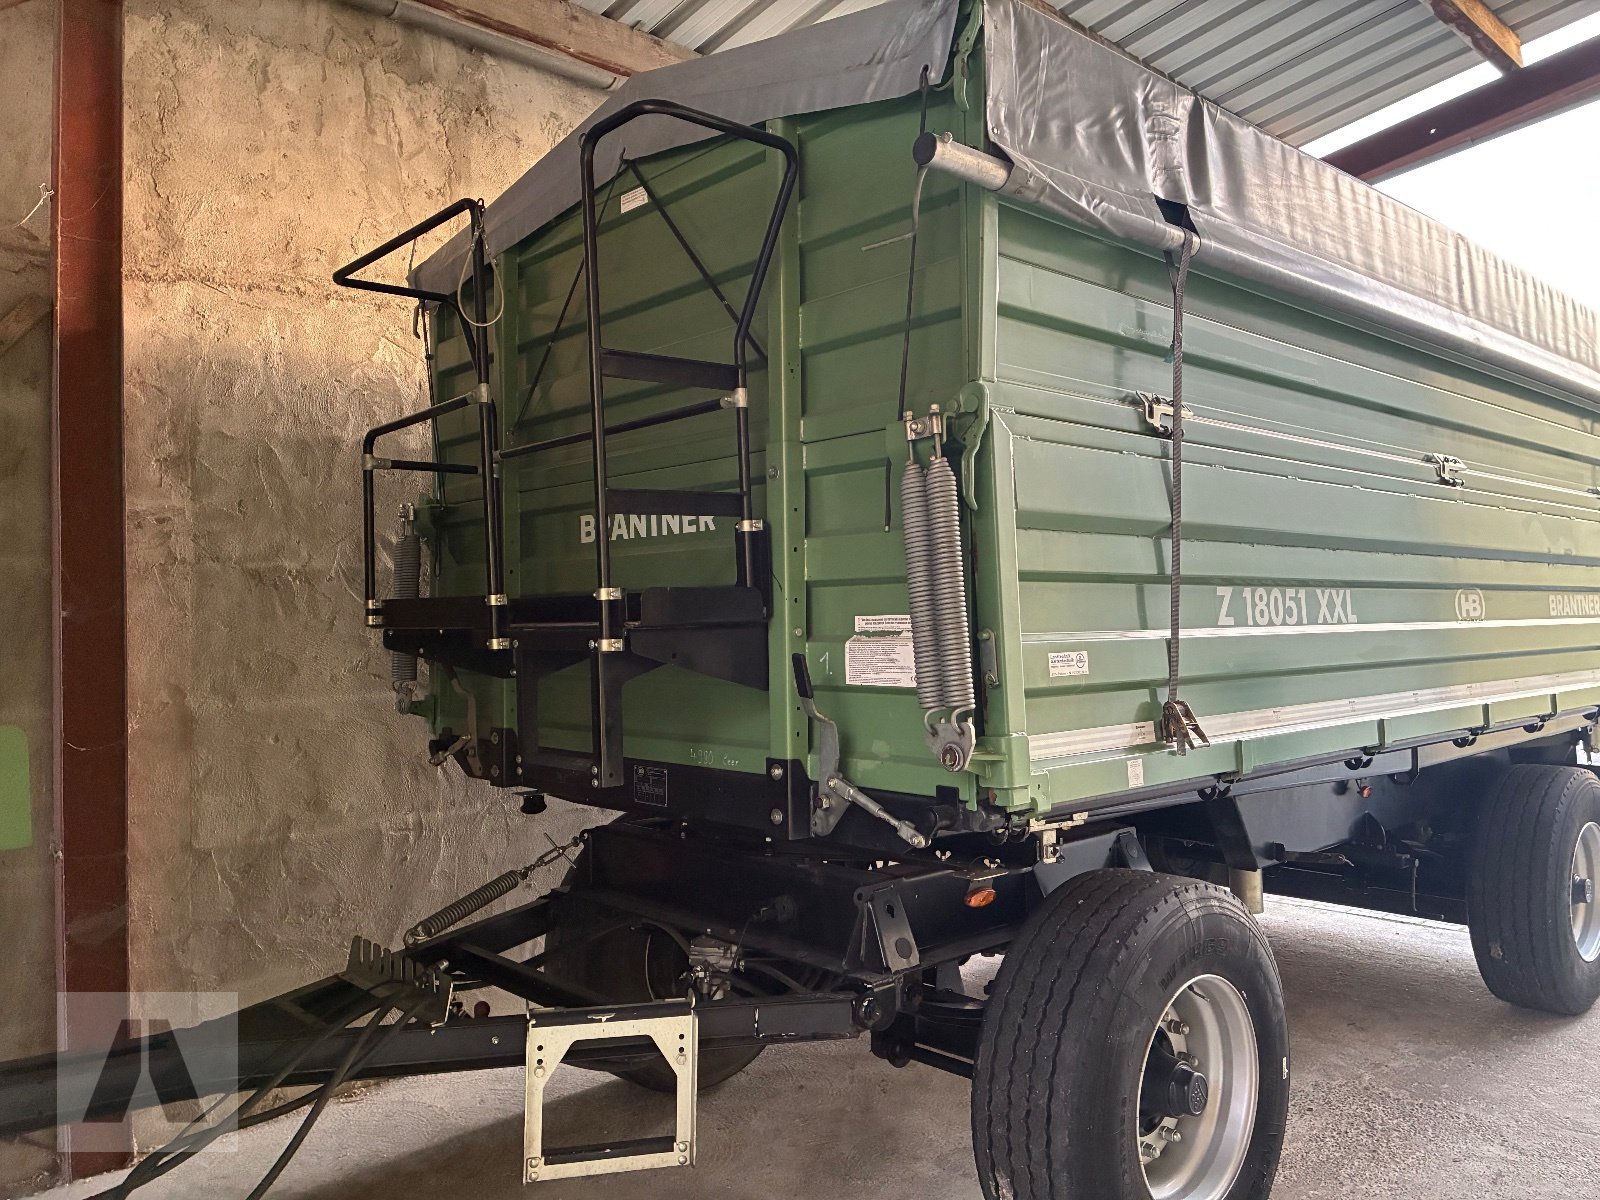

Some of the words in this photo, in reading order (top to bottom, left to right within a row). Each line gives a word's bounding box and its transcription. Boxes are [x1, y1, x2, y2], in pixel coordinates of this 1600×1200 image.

[580, 513, 716, 543] BANTNER
[1216, 586, 1235, 625] Z
[1242, 587, 1308, 625] 18051
[1315, 588, 1358, 624] XXL
[1549, 594, 1600, 616] BRANTNER
